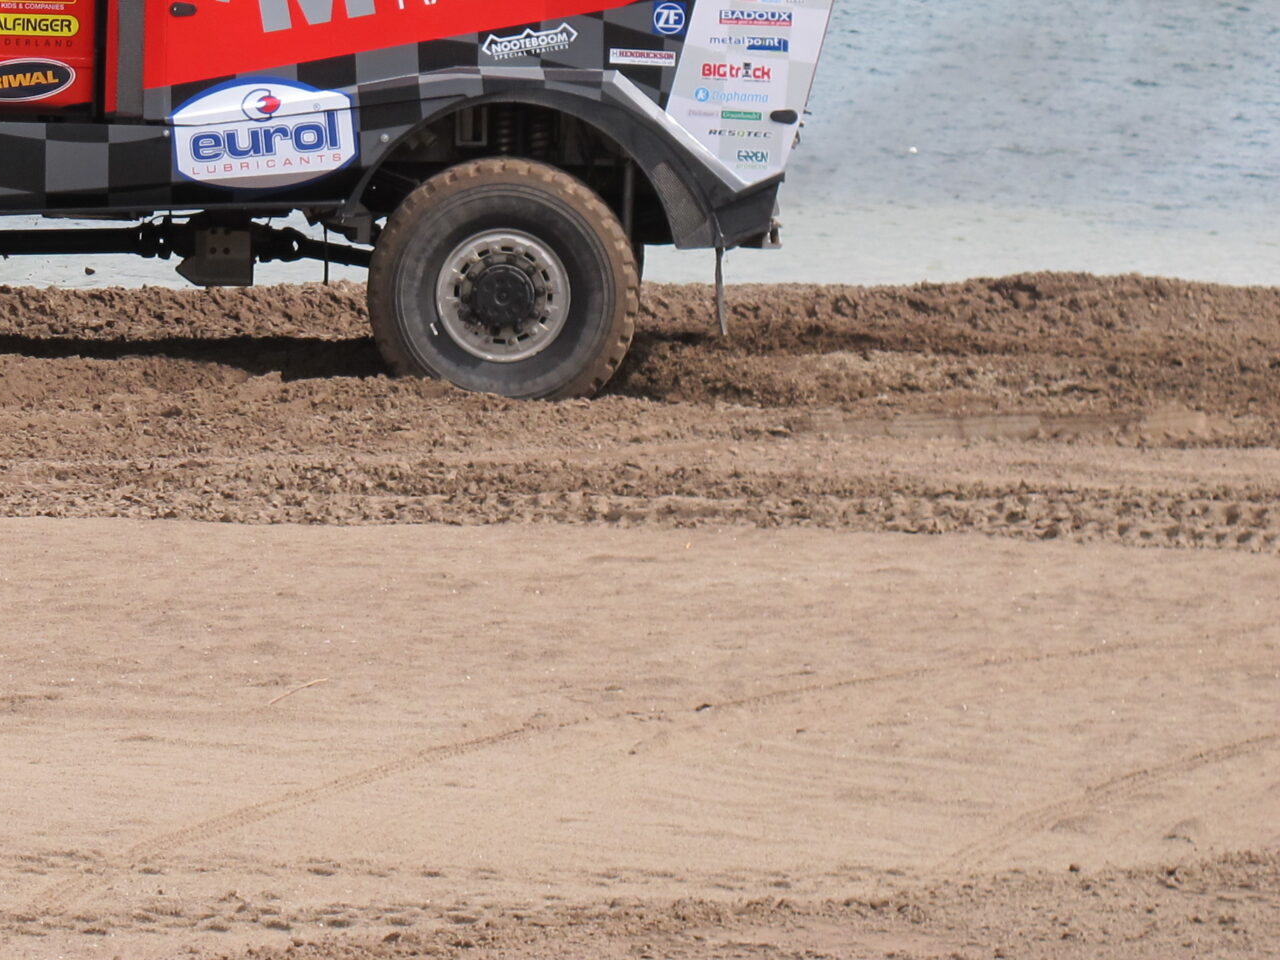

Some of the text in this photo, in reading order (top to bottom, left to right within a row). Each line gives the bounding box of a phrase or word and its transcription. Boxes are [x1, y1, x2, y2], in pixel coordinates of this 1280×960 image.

[657, 8, 682, 28] ZF
[721, 10, 790, 21] BADOUX
[491, 32, 569, 53] NOOTEBOOM
[494, 44, 569, 60] SPECIAL TRAILERS
[619, 50, 674, 60] HENDRICKSON
[711, 90, 769, 102] Dopharma
[190, 110, 341, 162] eurol
[192, 152, 342, 175] LUBRICANTS
